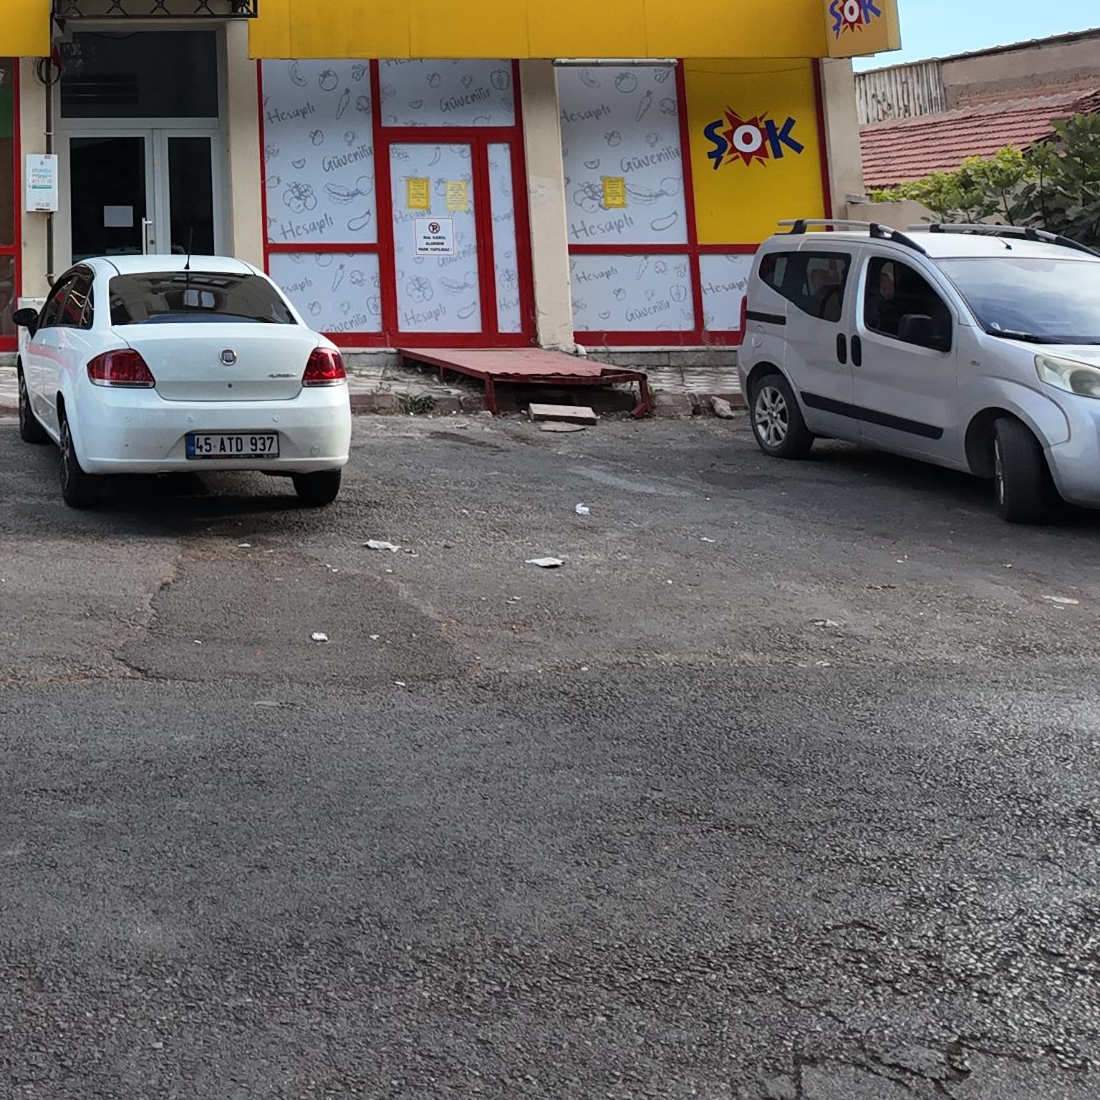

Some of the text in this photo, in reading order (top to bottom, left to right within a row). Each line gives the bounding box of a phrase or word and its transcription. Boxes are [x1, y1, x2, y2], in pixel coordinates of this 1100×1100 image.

[440, 87, 491, 112] Güvenilir
[266, 102, 316, 124] Hesaplı
[703, 116, 805, 170] ŞOK
[281, 214, 334, 240] Hesaplı
[571, 213, 634, 239] Hesaplı
[280, 276, 313, 294] esaplı
[575, 266, 618, 284] Hesaplı
[701, 276, 748, 295] Hesapl
[404, 303, 447, 326] Hesaplı
[625, 300, 670, 322] Güvenilir
[196, 436, 274, 453] 45 ATD 937
